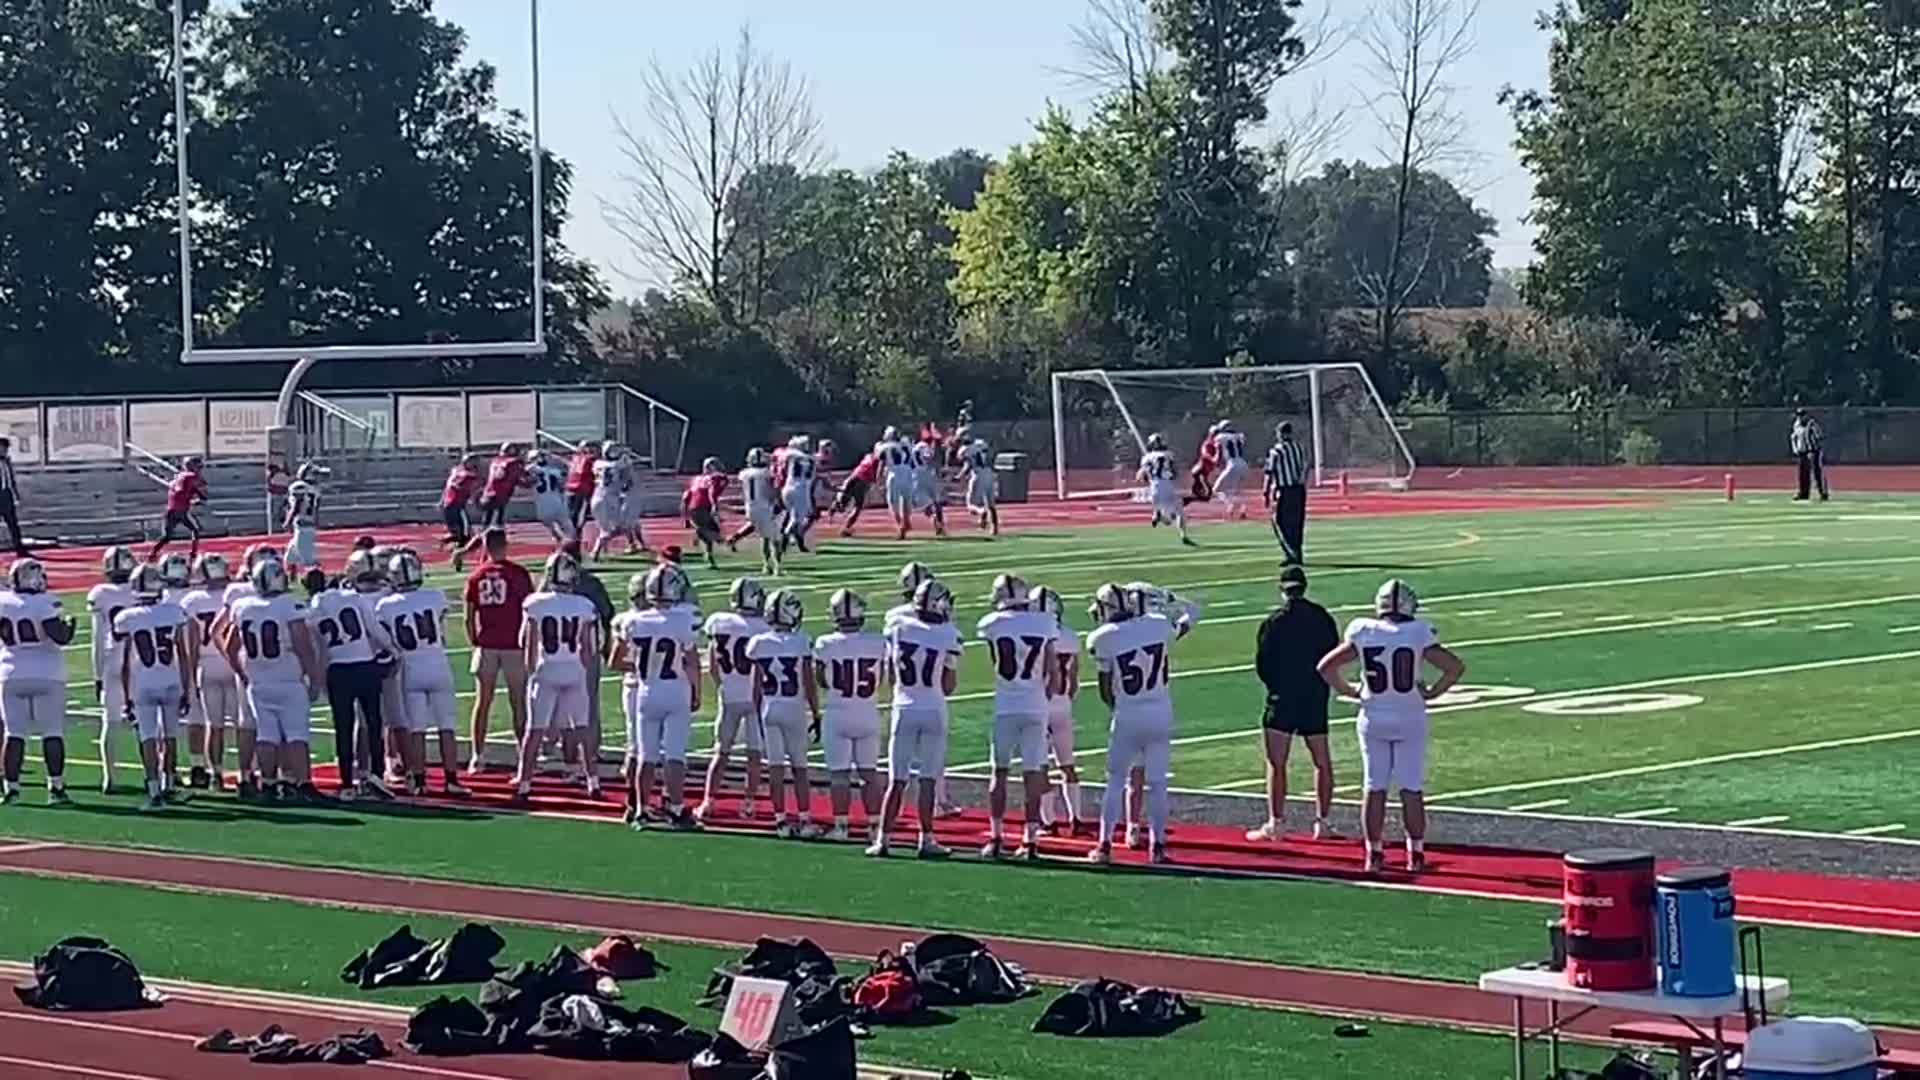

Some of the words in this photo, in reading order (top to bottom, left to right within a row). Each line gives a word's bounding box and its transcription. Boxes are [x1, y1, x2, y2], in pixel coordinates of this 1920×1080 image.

[478, 578, 508, 606] 23
[319, 608, 361, 648] 29
[395, 609, 437, 651] 64
[634, 637, 677, 681] 72
[761, 655, 799, 697] 33
[832, 657, 877, 699] 45
[1117, 642, 1164, 696] 57
[1363, 646, 1415, 693] 50
[733, 990, 774, 1041] 40
